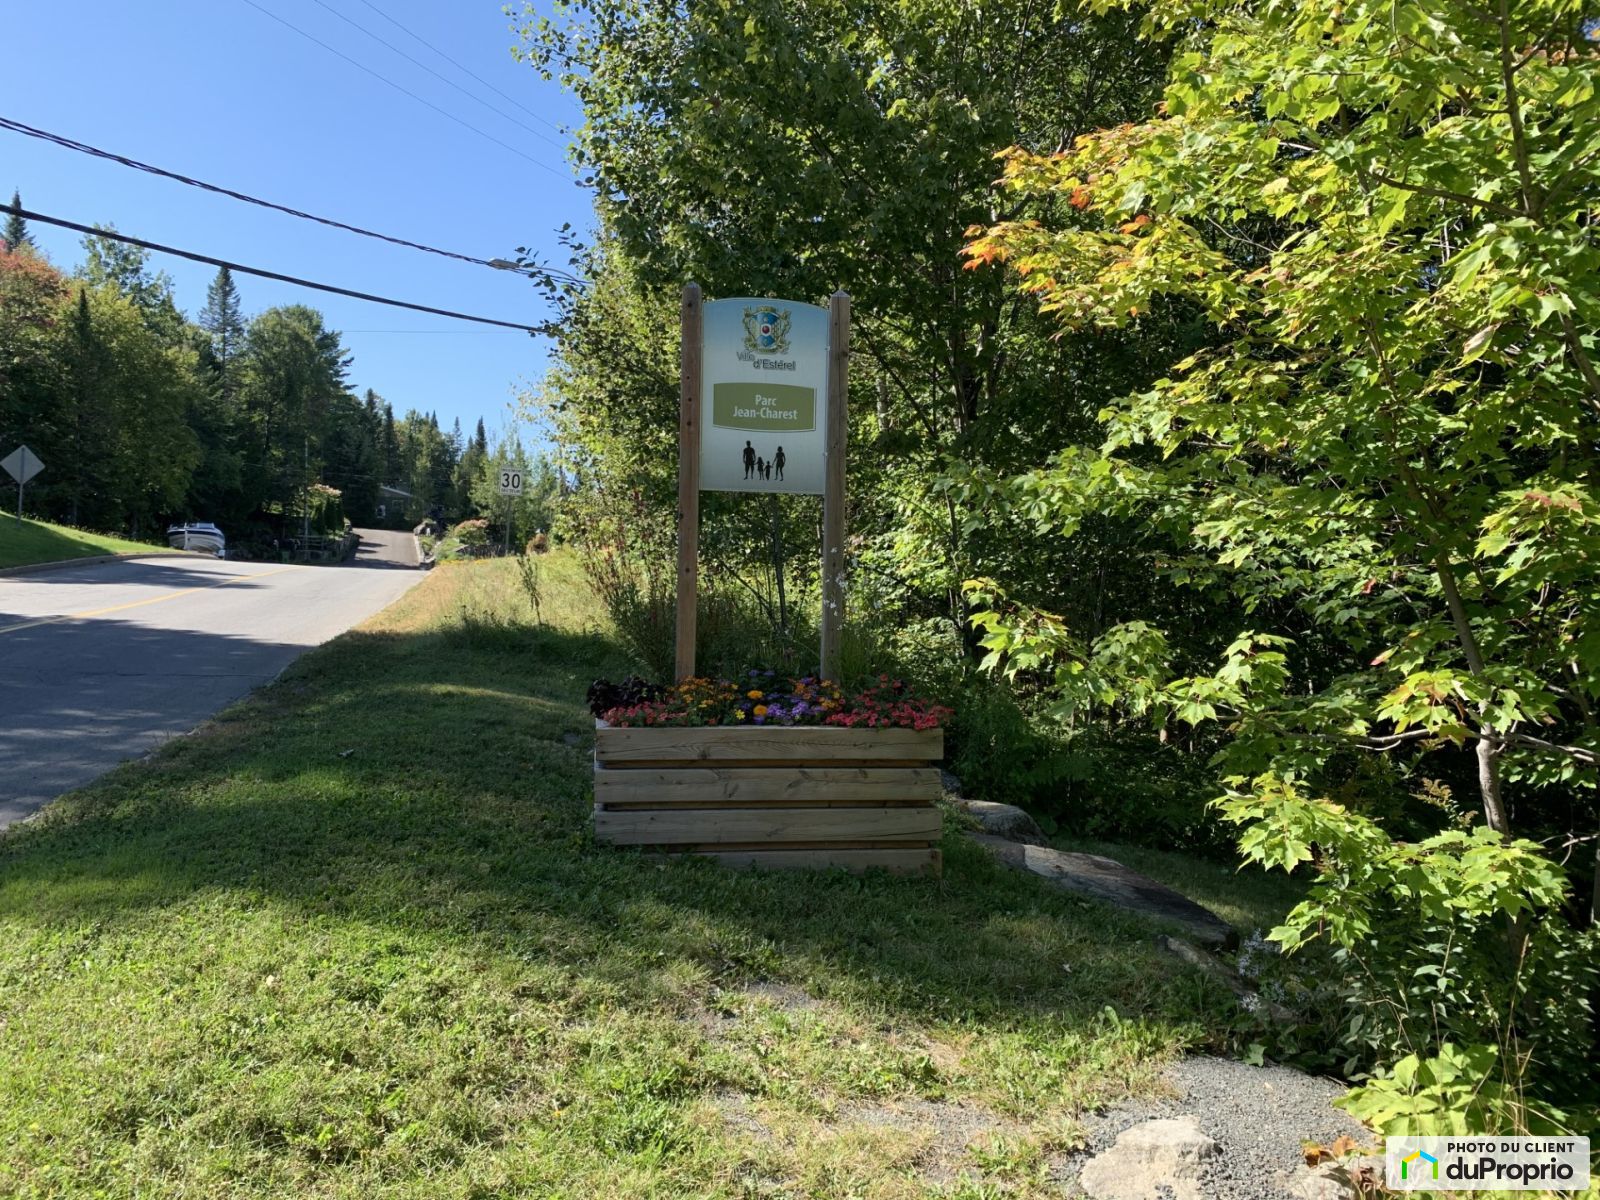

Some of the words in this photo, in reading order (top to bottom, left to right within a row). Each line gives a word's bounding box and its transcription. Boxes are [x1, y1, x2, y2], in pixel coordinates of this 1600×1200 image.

[736, 351, 756, 361] Ville
[752, 359, 797, 371] d'Estérel
[755, 394, 777, 406] Parc
[733, 406, 798, 420] Jean-Charest
[502, 472, 520, 488] 30
